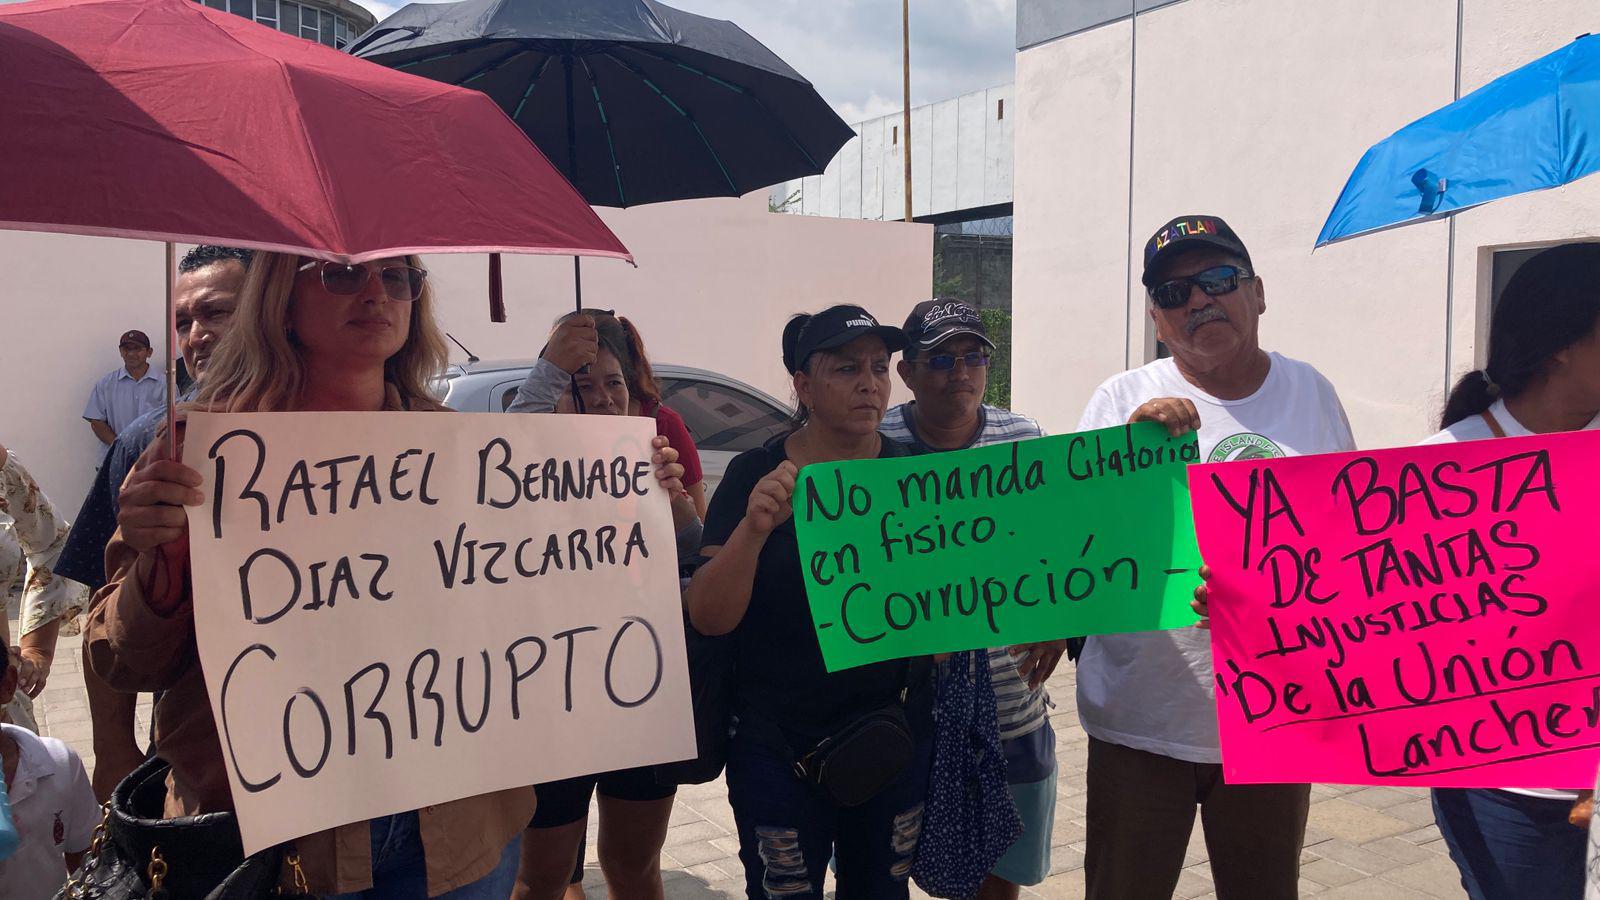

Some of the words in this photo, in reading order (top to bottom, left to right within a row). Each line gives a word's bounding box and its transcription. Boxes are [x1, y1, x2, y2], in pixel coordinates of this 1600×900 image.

[846, 319, 873, 328] PUMA
[208, 428, 440, 539] RAFAEL
[477, 437, 650, 509] BERNABE
[806, 469, 872, 522] No
[897, 442, 1046, 508] manda
[1219, 436, 1263, 454] ISLAND
[1210, 468, 1305, 570] YA
[1331, 449, 1561, 536] BASTA
[238, 547, 394, 625] DIAZ
[433, 522, 650, 590] VIZCARRA
[810, 543, 861, 585] en
[1257, 543, 1340, 609] DE
[1340, 520, 1541, 599] TANTAS
[1255, 574, 1548, 668] INJUSTICIAS
[220, 615, 663, 793] CORRUPTO
[1324, 668, 1376, 713] la
[1393, 626, 1583, 706] Unión
